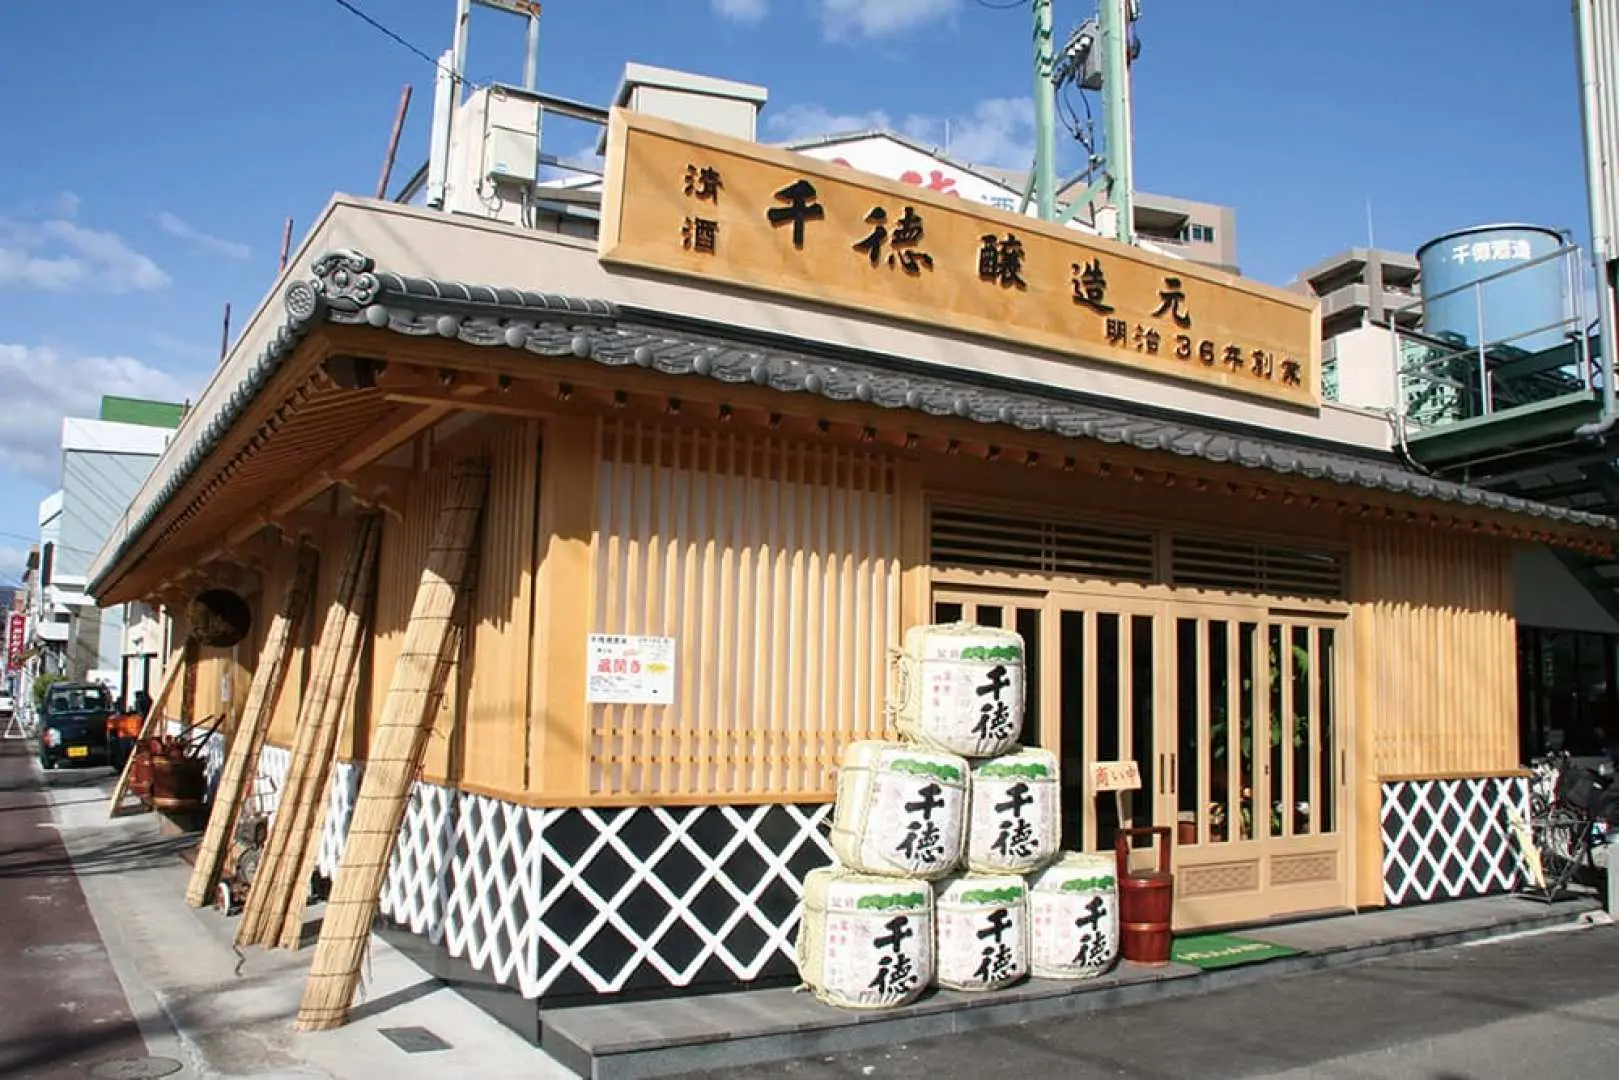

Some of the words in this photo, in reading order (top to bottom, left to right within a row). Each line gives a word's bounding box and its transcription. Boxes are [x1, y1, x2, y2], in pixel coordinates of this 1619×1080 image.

[970, 664, 1013, 740] 千徳
[896, 782, 945, 863] 千徳
[991, 781, 1039, 857] 千徳
[867, 915, 918, 994] 千徳
[973, 908, 1017, 983] 千徳
[1072, 896, 1110, 967] 千徳
